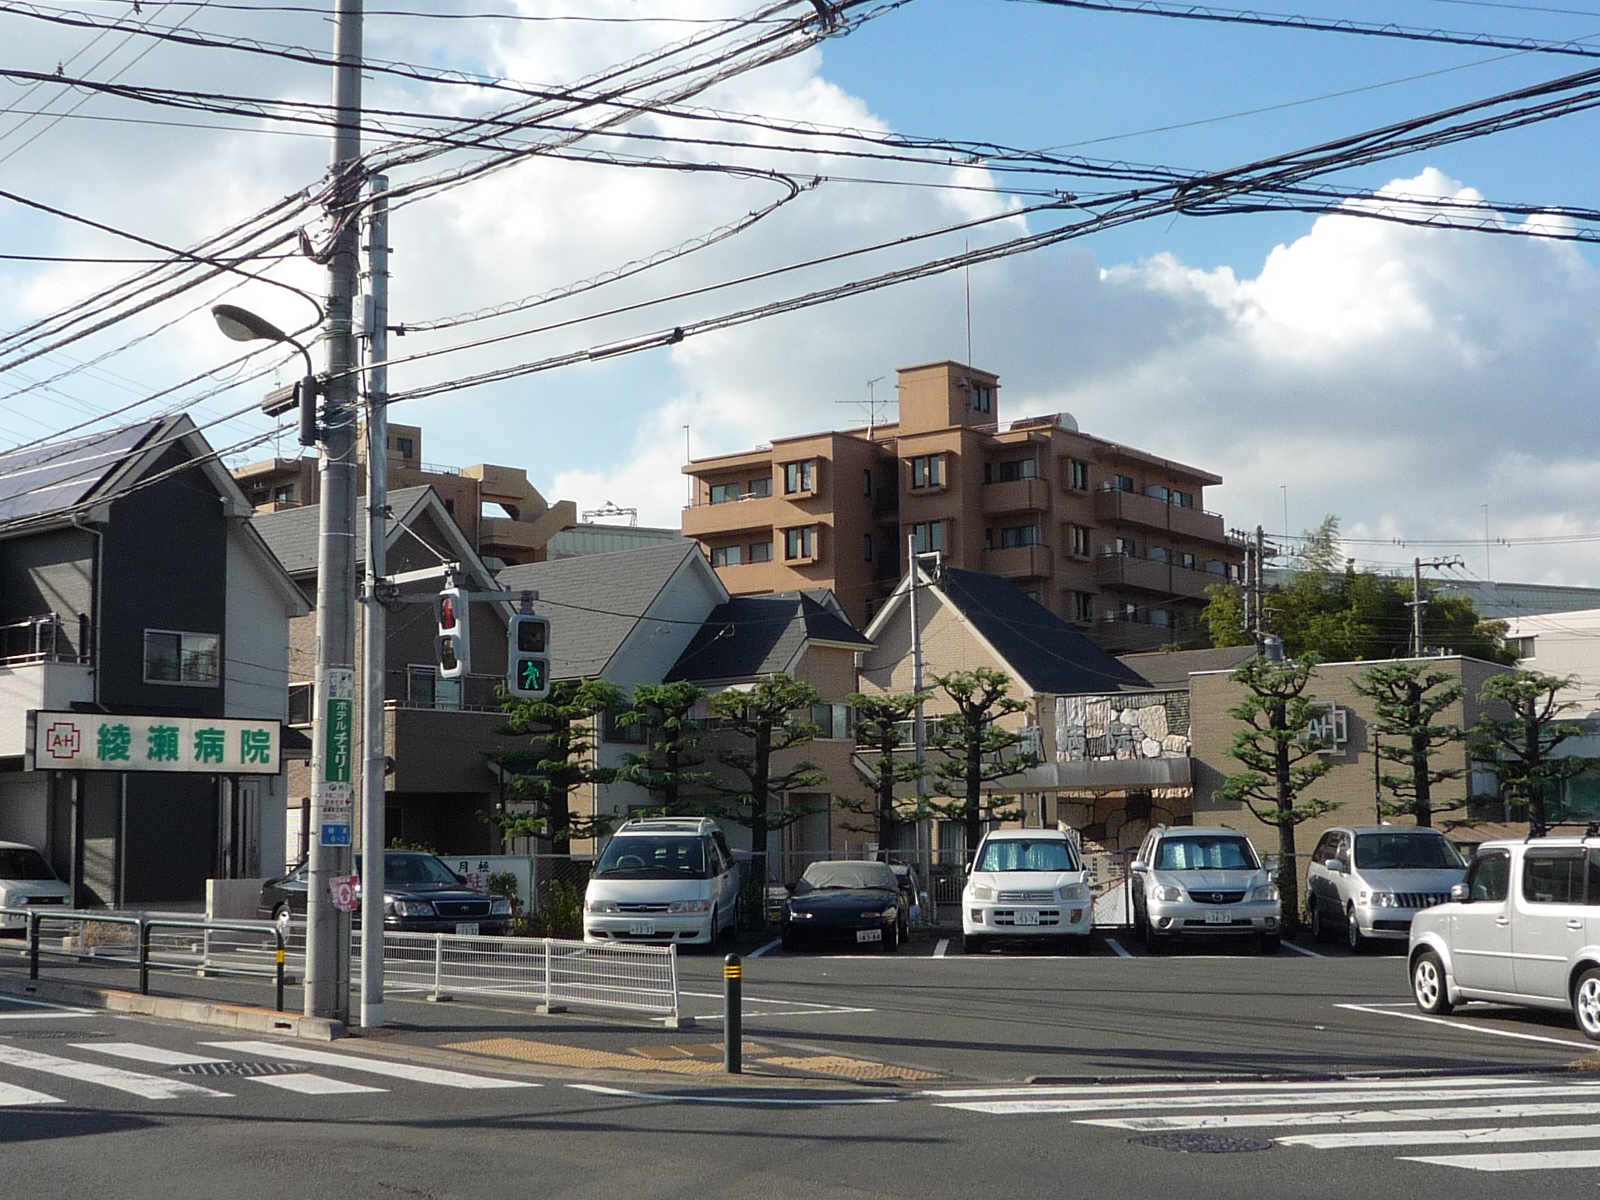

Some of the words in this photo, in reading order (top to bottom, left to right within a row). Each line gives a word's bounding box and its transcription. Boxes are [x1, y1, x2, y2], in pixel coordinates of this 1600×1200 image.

[96, 723, 271, 765] 綾瀬病院
[333, 701, 348, 781] ホテルチェリー
[458, 861, 490, 873] 月極
